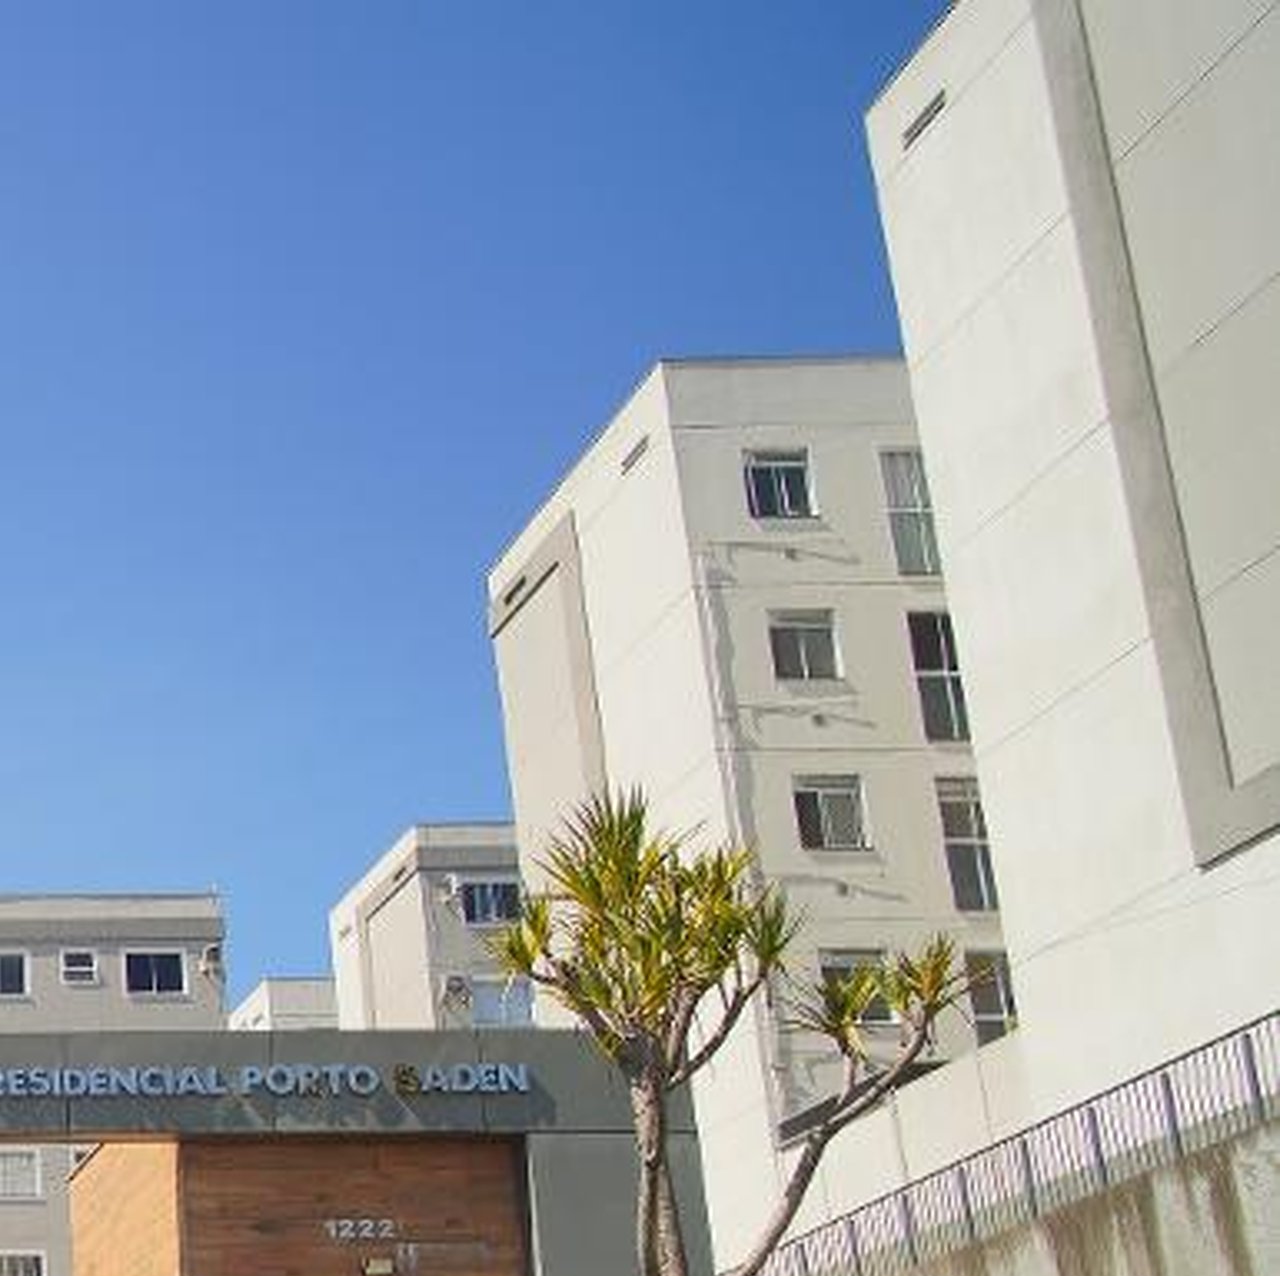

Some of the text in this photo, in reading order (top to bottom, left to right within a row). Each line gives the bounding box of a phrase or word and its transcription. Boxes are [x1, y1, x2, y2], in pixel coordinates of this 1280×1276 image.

[240, 1064, 380, 1097] PORTO
[393, 1063, 531, 1098] ADEN
[324, 1218, 395, 1239] 1222
